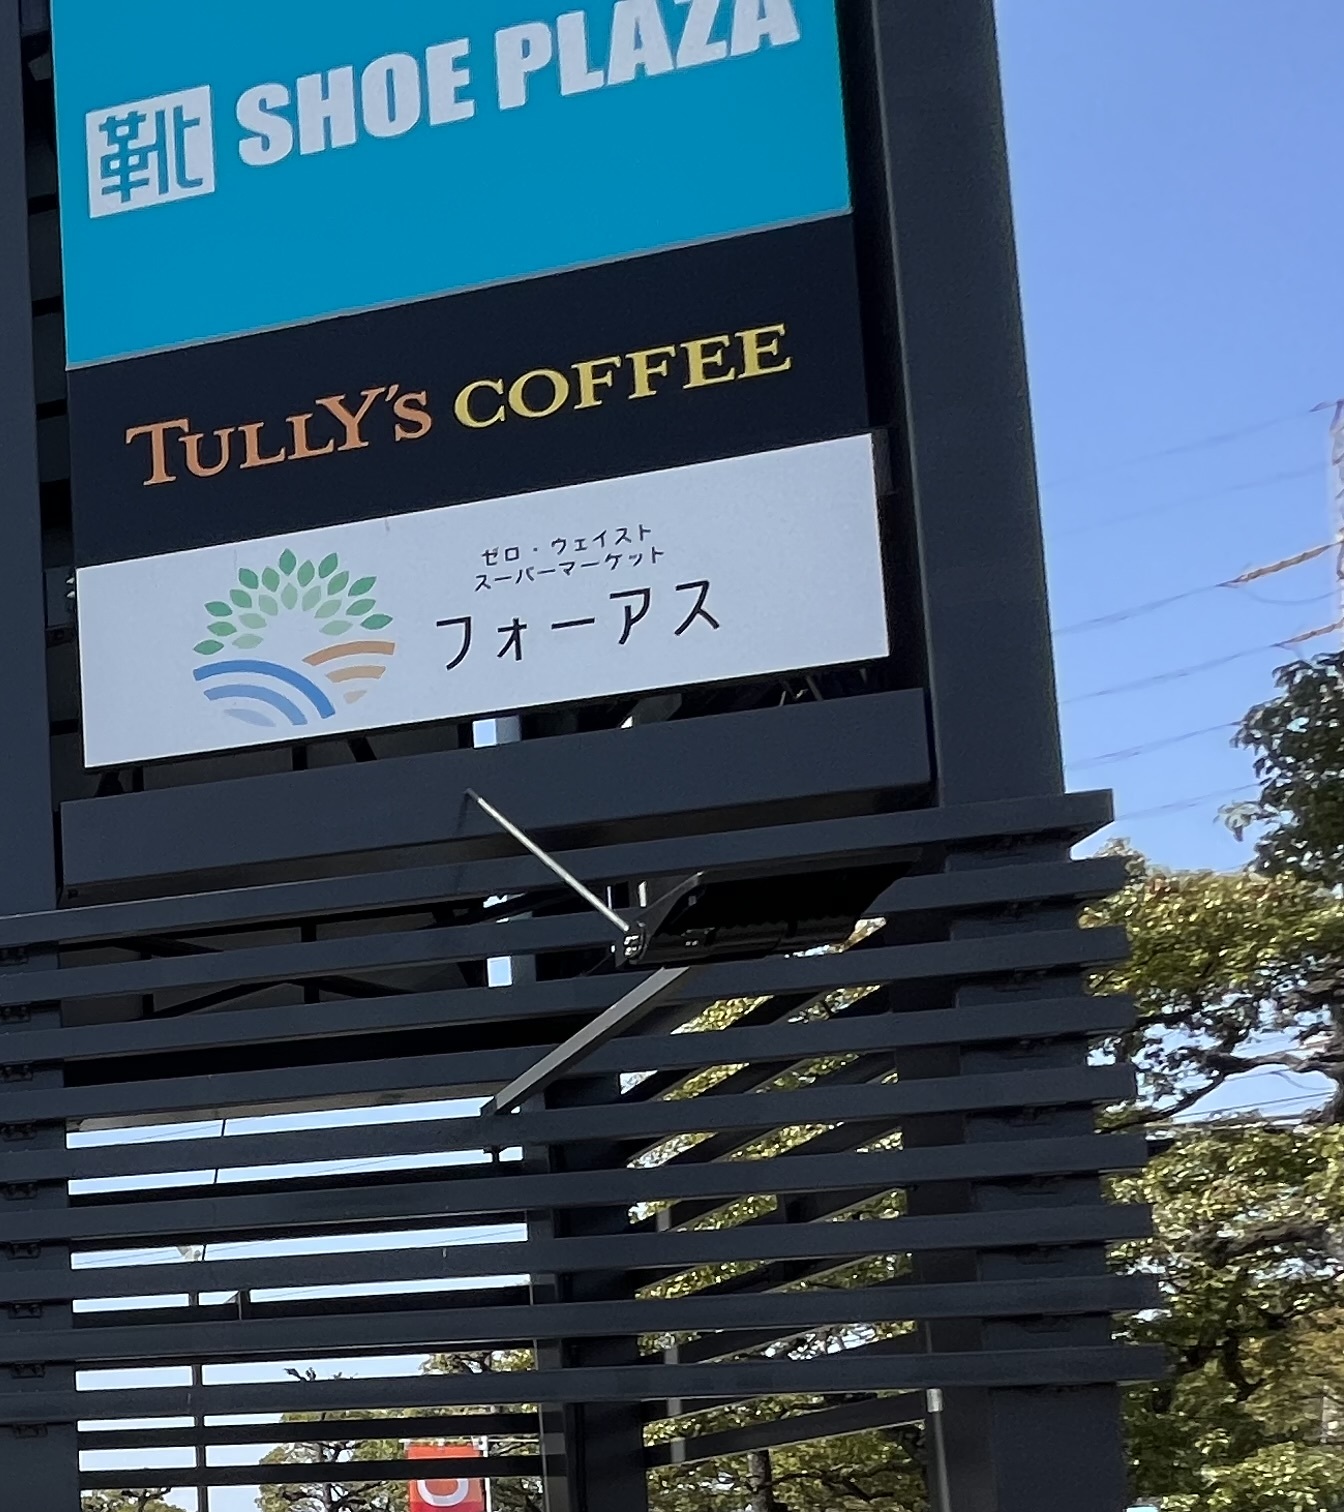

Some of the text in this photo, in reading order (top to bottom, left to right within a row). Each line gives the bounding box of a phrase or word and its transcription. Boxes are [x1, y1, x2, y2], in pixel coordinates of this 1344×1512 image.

[235, 0, 801, 167] SHOE PLAZA
[100, 109, 202, 204] 靴
[453, 323, 793, 429] COFFEE
[474, 545, 665, 593] スーパーマーケット
[435, 577, 720, 671] フォーアス
